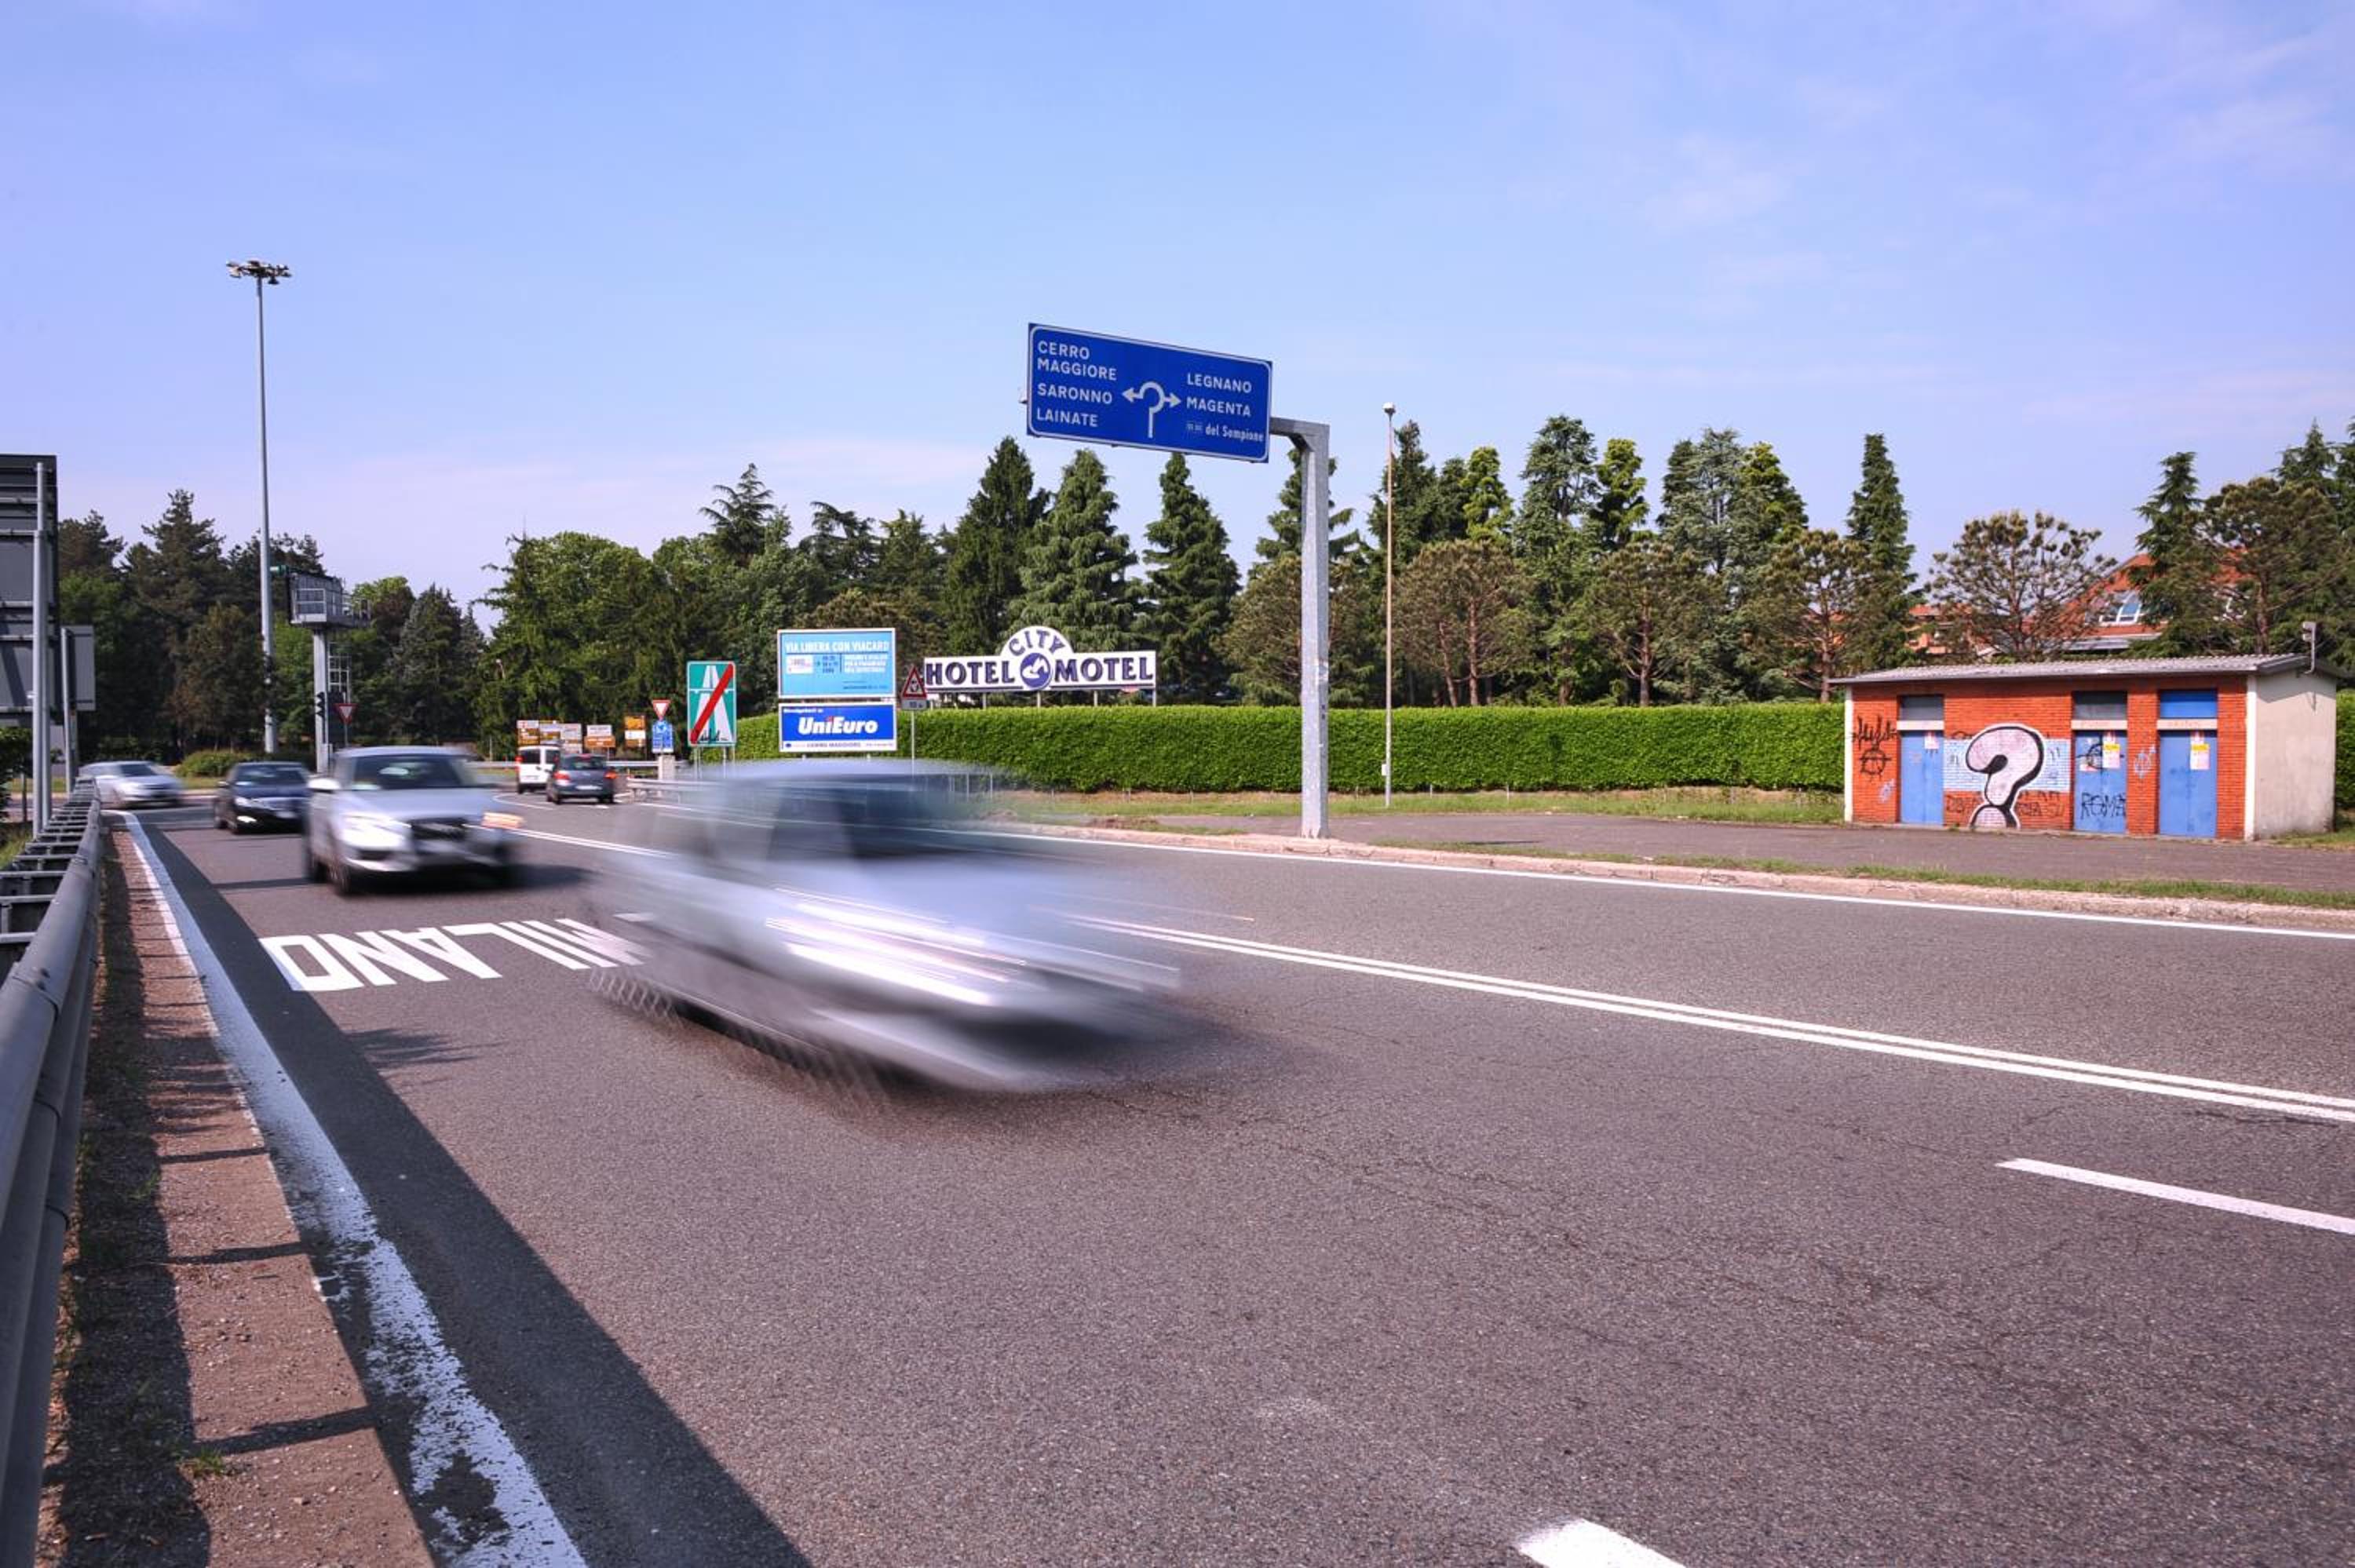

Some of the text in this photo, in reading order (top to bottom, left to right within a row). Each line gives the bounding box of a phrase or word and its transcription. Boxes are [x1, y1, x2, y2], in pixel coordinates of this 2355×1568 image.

[1037, 340, 1090, 360] CERRO
[1037, 359, 1117, 381] MAGGIORE
[1187, 373, 1252, 393] LEGNANO
[1037, 383, 1113, 405] SARONNO
[1186, 396, 1251, 418] MAGENTA
[1037, 408, 1099, 428] LAINATE
[1205, 423, 1219, 436] del
[786, 641, 799, 652] VIA
[1009, 629, 1066, 656] CITY
[926, 658, 1153, 685] HOTEL MOTEL
[798, 716, 878, 735] UniEuro
[258, 917, 645, 991] MILANO
